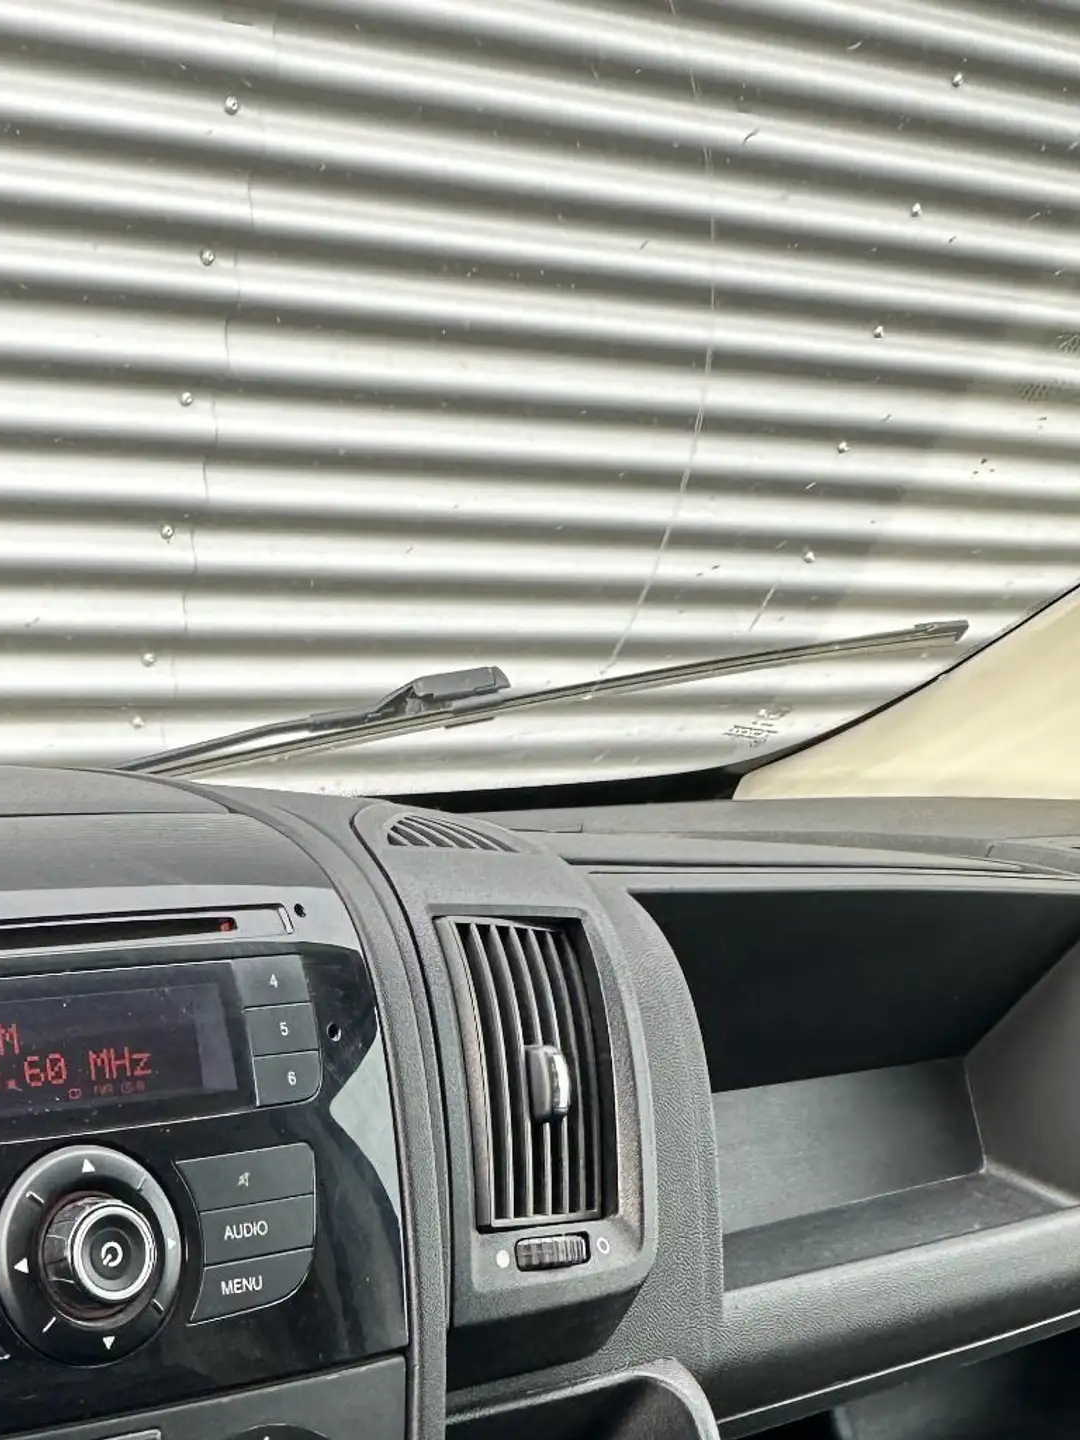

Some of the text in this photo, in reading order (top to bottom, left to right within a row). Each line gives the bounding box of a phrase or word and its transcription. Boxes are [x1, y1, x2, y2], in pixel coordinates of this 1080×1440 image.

[269, 973, 279, 989] 4
[280, 1021, 289, 1036] 5
[87, 1047, 152, 1080] MHz
[287, 1071, 297, 1086] 6
[223, 1220, 269, 1241] AUDIO
[220, 1275, 263, 1296] MENU
